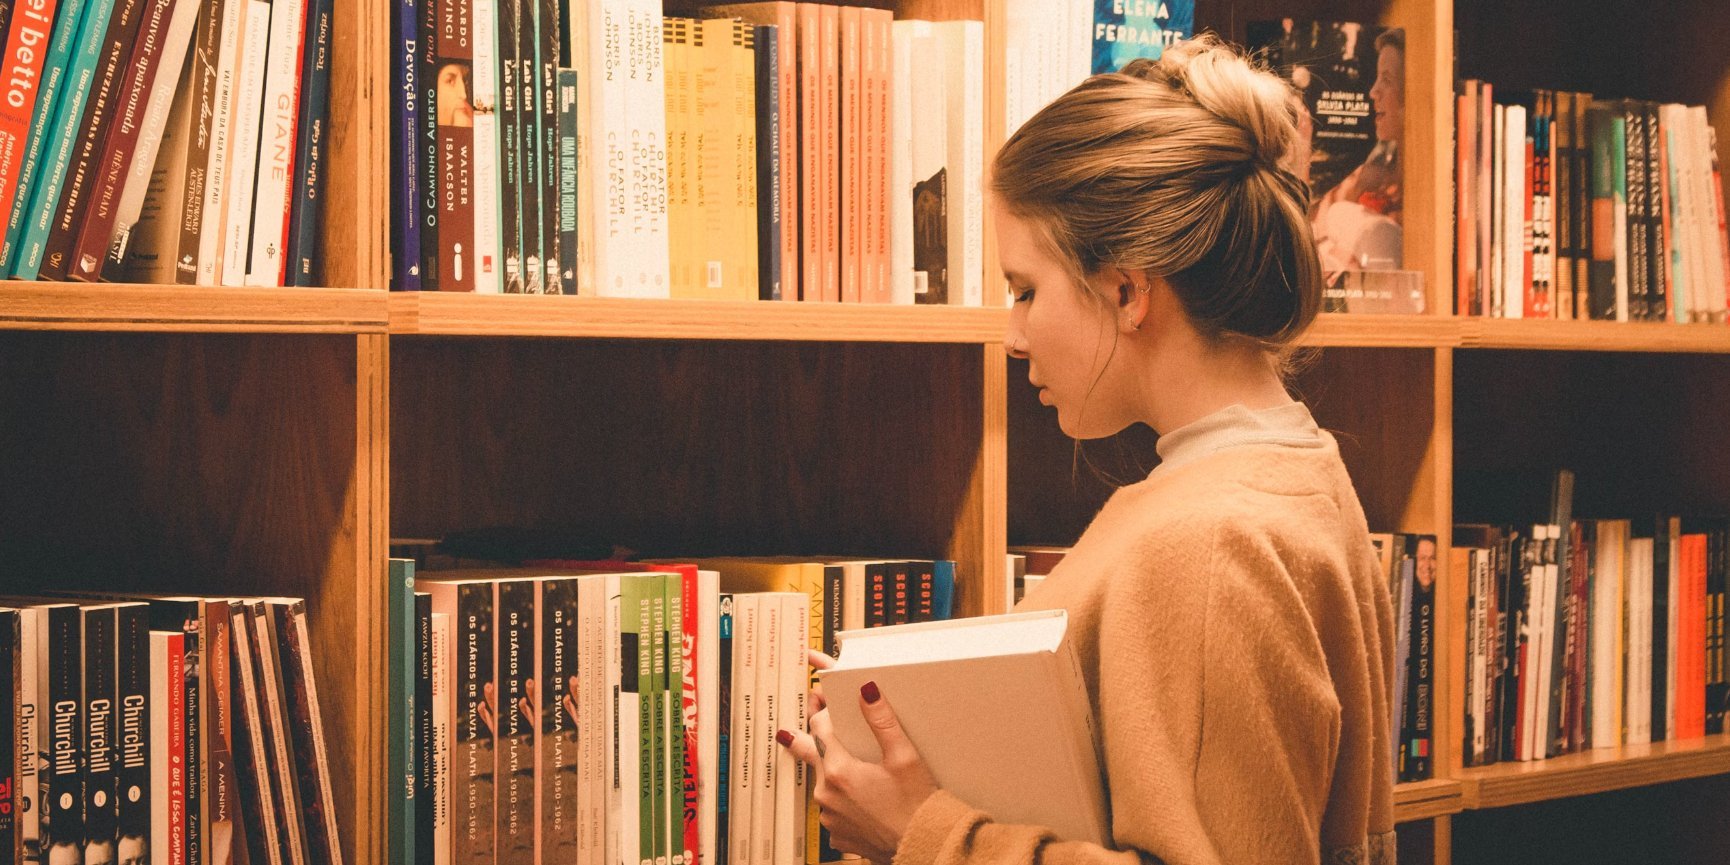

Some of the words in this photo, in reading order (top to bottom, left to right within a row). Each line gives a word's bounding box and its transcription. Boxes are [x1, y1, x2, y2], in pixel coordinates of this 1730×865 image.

[1113, 0, 1170, 20] ELENA
[318, 12, 328, 44] Forjaz
[628, 10, 637, 79] JOHNSON
[316, 48, 326, 71] Teca
[605, 9, 613, 81] JOHNSON
[644, 13, 653, 82] JOHNSON
[653, 26, 661, 68] BORIS
[7, 26, 45, 108] betto
[50, 66, 61, 88] Uma
[79, 68, 90, 89] Uma
[402, 39, 416, 111] Devoção
[504, 60, 513, 83] Lab
[524, 60, 532, 83] Lab
[545, 63, 553, 87] Lab
[87, 41, 122, 140] ENCRUZILHADAS
[121, 56, 150, 134] apaixonada
[221, 84, 230, 115] EMBORA
[505, 87, 513, 111] Girl
[524, 87, 533, 111] Girl
[545, 90, 553, 114] Girl
[35, 90, 54, 136] esperança
[65, 91, 83, 137] esperança
[219, 117, 226, 128] DA
[427, 88, 436, 140] ABERTO
[30, 137, 41, 161] mais
[58, 138, 70, 161] mais
[82, 142, 93, 158] DA
[216, 130, 225, 148] CASA
[272, 93, 291, 181] GIANE
[562, 137, 575, 155] UMA
[640, 148, 647, 159] O
[22, 161, 35, 183] forte
[214, 153, 222, 164] DE
[617, 151, 624, 160] O
[657, 151, 663, 161] O
[51, 161, 65, 184] forte
[195, 167, 204, 196] JAMES
[213, 167, 222, 185] TEUS
[427, 145, 436, 209] CAMINHO
[446, 137, 454, 212] ISAACSON
[460, 145, 468, 205] WALTER
[608, 131, 619, 237] CHURCHILL
[631, 129, 643, 234] CHURCHILL
[17, 184, 27, 203] que
[48, 185, 56, 204] que
[62, 160, 87, 231] LIBERDADE
[98, 184, 113, 219] FRAIN
[211, 186, 220, 204] PAIS
[10, 209, 20, 229] mar
[39, 209, 49, 230] mar
[191, 197, 203, 235] EDWARD
[427, 215, 436, 227] O
[561, 195, 576, 232] ROUBADA
[0, 241, 10, 266] ROCCO
[28, 242, 39, 267] ROCCO
[109, 222, 126, 261] BRASIL
[873, 575, 883, 616] SCOTT
[896, 574, 905, 616] SCOTT
[921, 573, 931, 614] SCOTT
[469, 616, 476, 629] OS
[510, 612, 517, 625] OS
[555, 610, 562, 624] OS
[641, 599, 650, 646] STEPHEN
[654, 598, 663, 645] STEPHEN
[671, 597, 681, 643] STEPHEN
[217, 622, 226, 687] SAMANTHA
[510, 630, 519, 676] DIÁRIOS
[555, 628, 563, 673] DIÁRIOS
[1420, 617, 1430, 659] LIVRO
[469, 633, 478, 680] DIÁRIOS
[641, 649, 650, 676] KING
[654, 648, 663, 674] KING
[672, 647, 681, 673] KING
[1419, 660, 1428, 679] DO
[469, 684, 476, 698] DE
[510, 680, 517, 693] DE
[555, 677, 562, 690] DE
[189, 687, 197, 714] Minha
[217, 690, 226, 735] GEIMER
[510, 697, 518, 735] SYLVIA
[641, 695, 649, 733] SOBRE
[655, 693, 663, 732] SOBRE
[672, 692, 680, 729] SOBRE
[55, 700, 77, 775] Churchill
[90, 698, 110, 773] Churchill
[123, 694, 144, 768] Churchill
[189, 718, 197, 735] vida
[469, 702, 477, 740] SYLVIA
[22, 703, 35, 776] Churchill
[673, 734, 680, 742] A
[218, 760, 225, 769] A
[510, 738, 518, 772] PLATH
[656, 747, 664, 796] ESCRITA
[673, 746, 681, 795] ESCRITA
[189, 765, 197, 798] traidora
[405, 774, 415, 799] Luigi
[642, 749, 650, 798] ESCRITA
[218, 773, 226, 822] MENINA
[554, 775, 562, 830] 1950-1962
